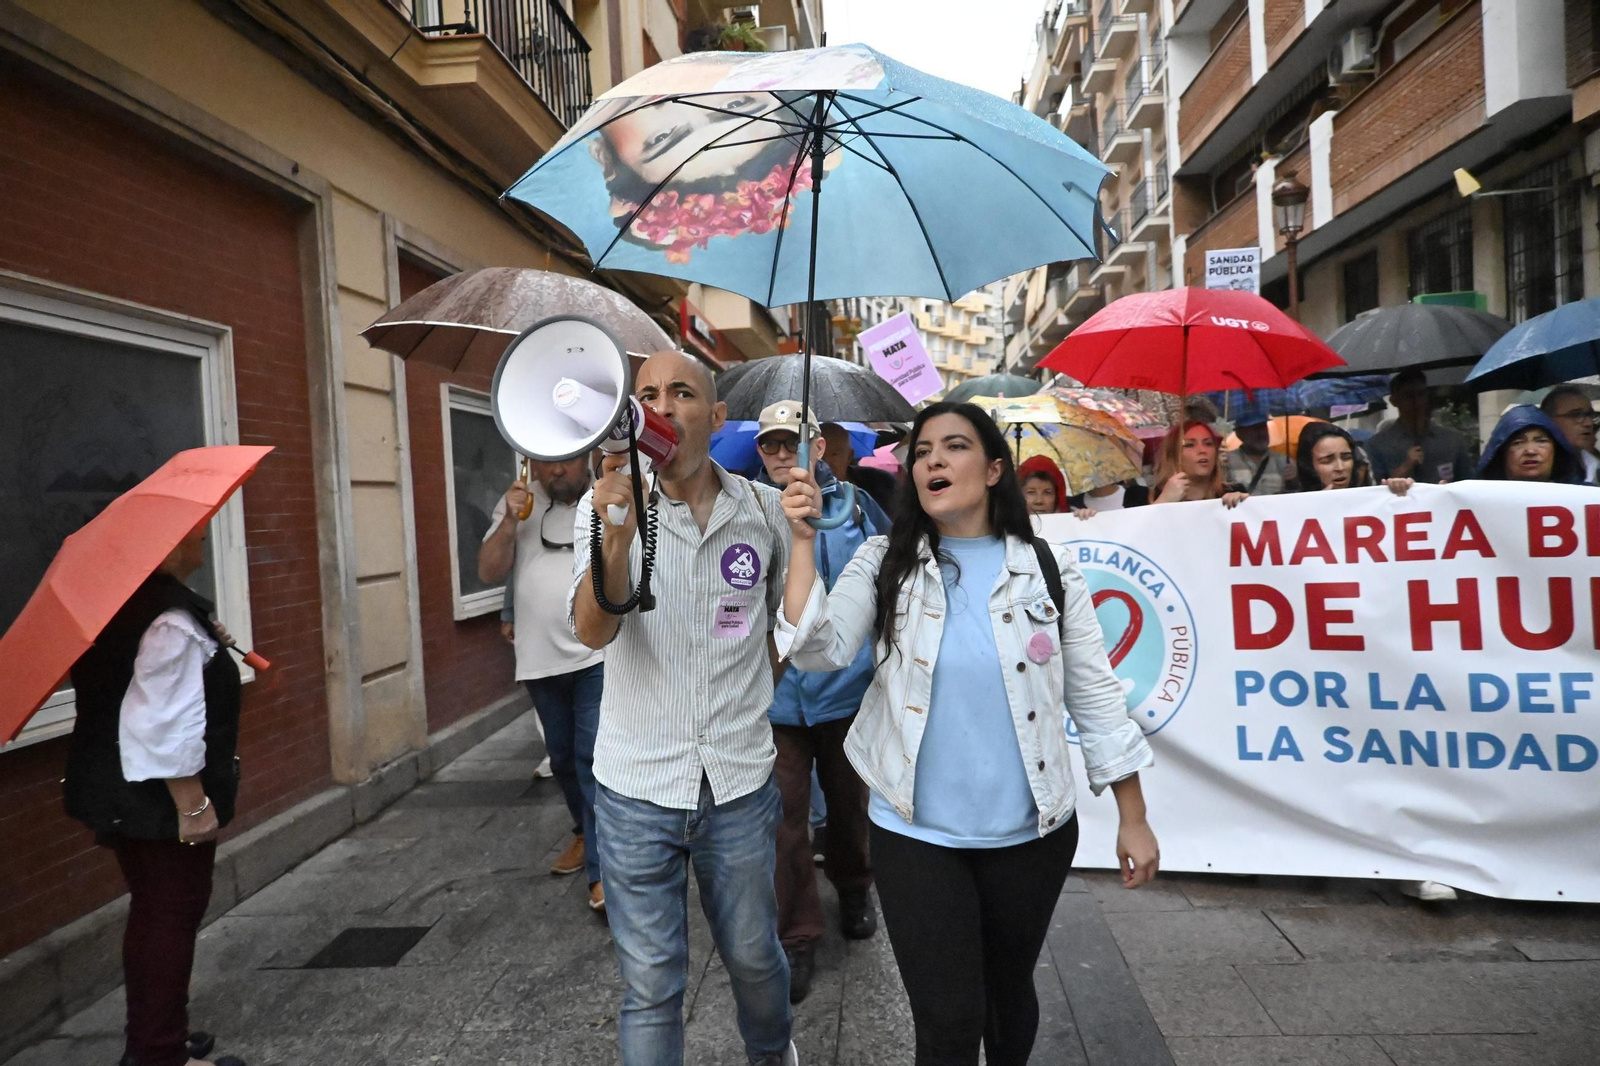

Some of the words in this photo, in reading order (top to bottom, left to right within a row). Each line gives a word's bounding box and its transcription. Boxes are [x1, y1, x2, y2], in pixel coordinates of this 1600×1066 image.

[1208, 265, 1254, 276] PÚBLICA
[1209, 254, 1255, 265] SANIDAD
[1210, 315, 1250, 329] UGT
[881, 340, 907, 358] MATA
[1230, 510, 1496, 566] MAREA
[1078, 547, 1166, 599] BLANCA
[1231, 583, 1365, 651] DE
[1407, 577, 1600, 651] HU
[1157, 625, 1193, 703] PÚBLICA
[1235, 669, 1350, 709] POR
[1368, 672, 1446, 712] LA
[1467, 672, 1595, 714] DEF
[1236, 724, 1305, 763] LA
[1322, 725, 1600, 773] SANIDAD
